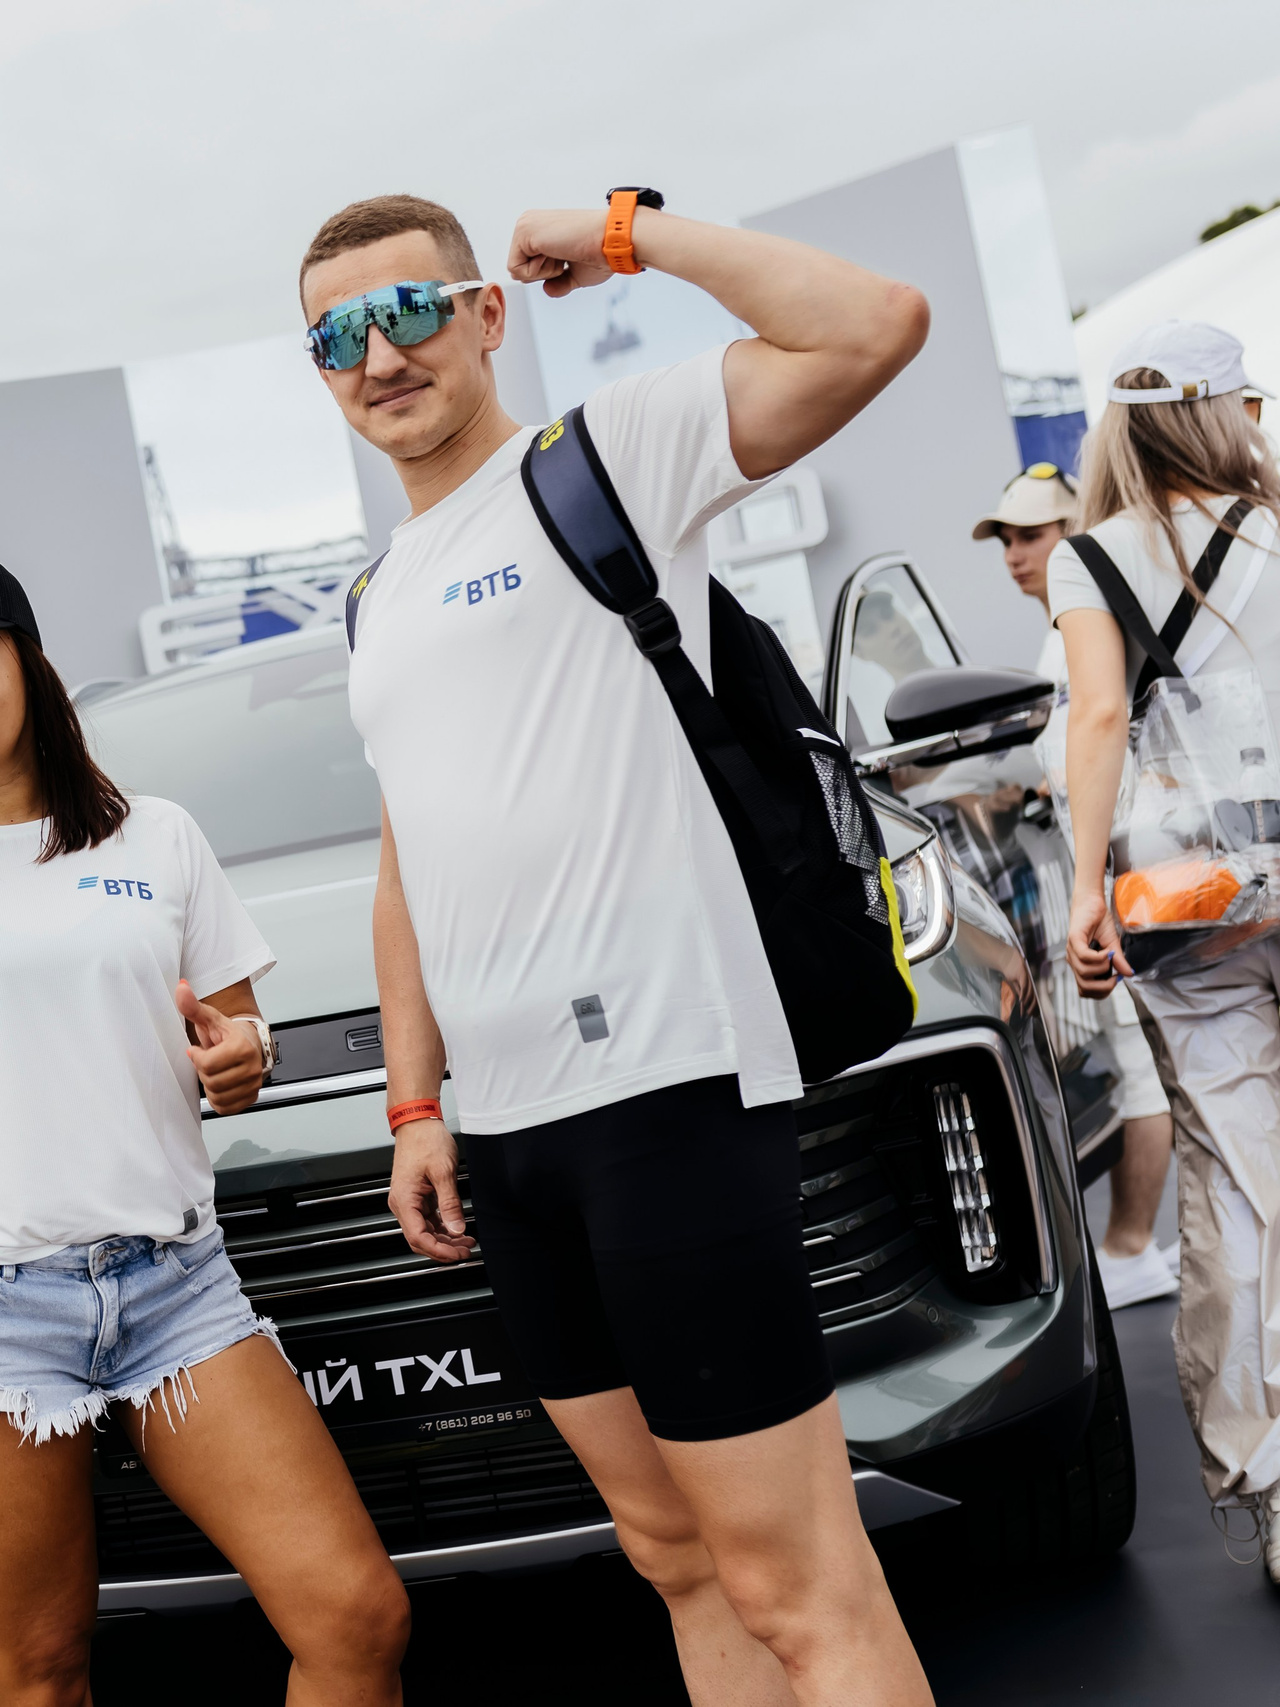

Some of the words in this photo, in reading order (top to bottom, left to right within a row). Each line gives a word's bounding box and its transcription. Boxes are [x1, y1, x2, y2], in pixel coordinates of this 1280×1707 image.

[540, 419, 565, 451] 13
[466, 563, 522, 606] ВТБ
[103, 879, 153, 901] ВТБ
[374, 1348, 502, 1396] TXL
[435, 1416, 468, 1431] (861)
[470, 1413, 495, 1426] 202
[497, 1411, 513, 1422] 96
[515, 1408, 532, 1419] 50
